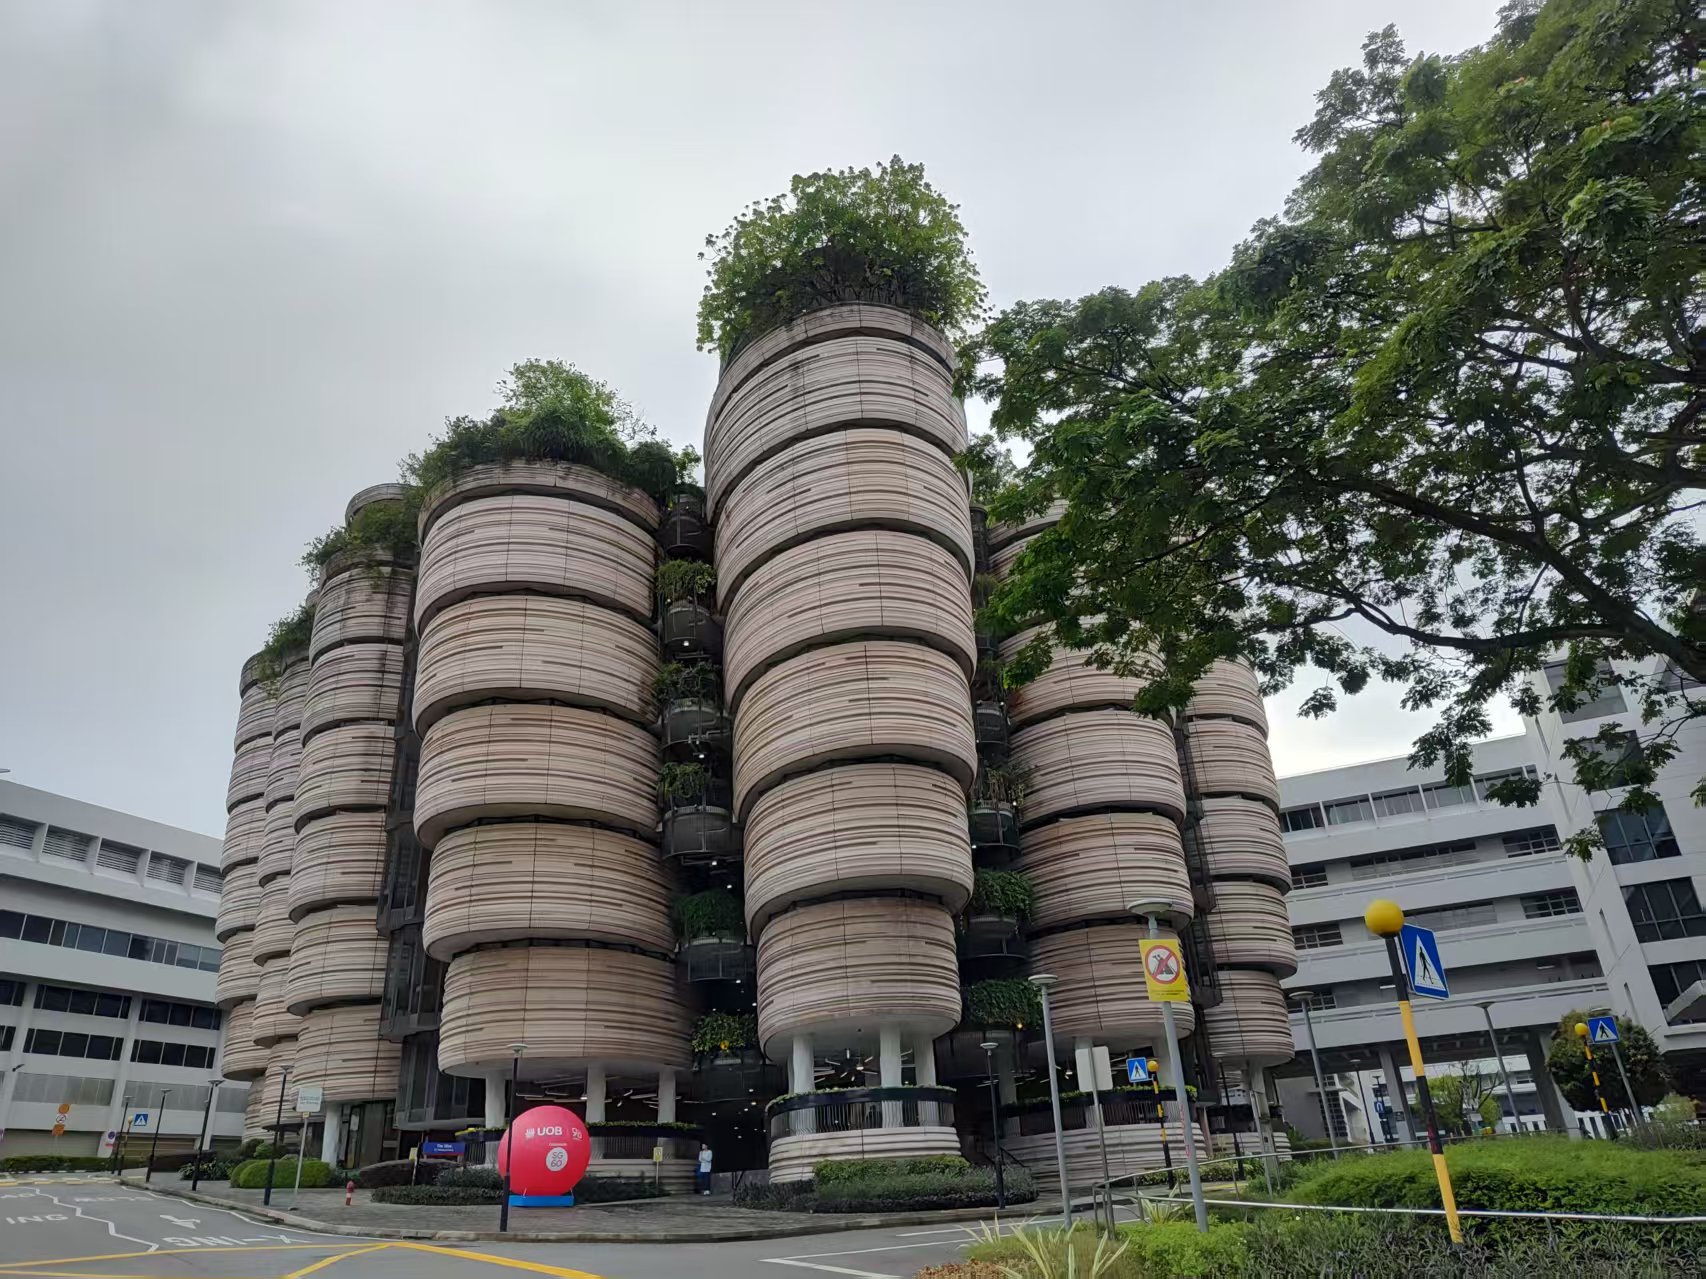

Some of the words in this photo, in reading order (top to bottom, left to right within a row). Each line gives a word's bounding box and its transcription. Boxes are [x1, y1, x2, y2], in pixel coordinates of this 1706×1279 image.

[537, 1126, 563, 1136] UOB
[551, 1151, 564, 1160] SG
[550, 1159, 563, 1168] 60
